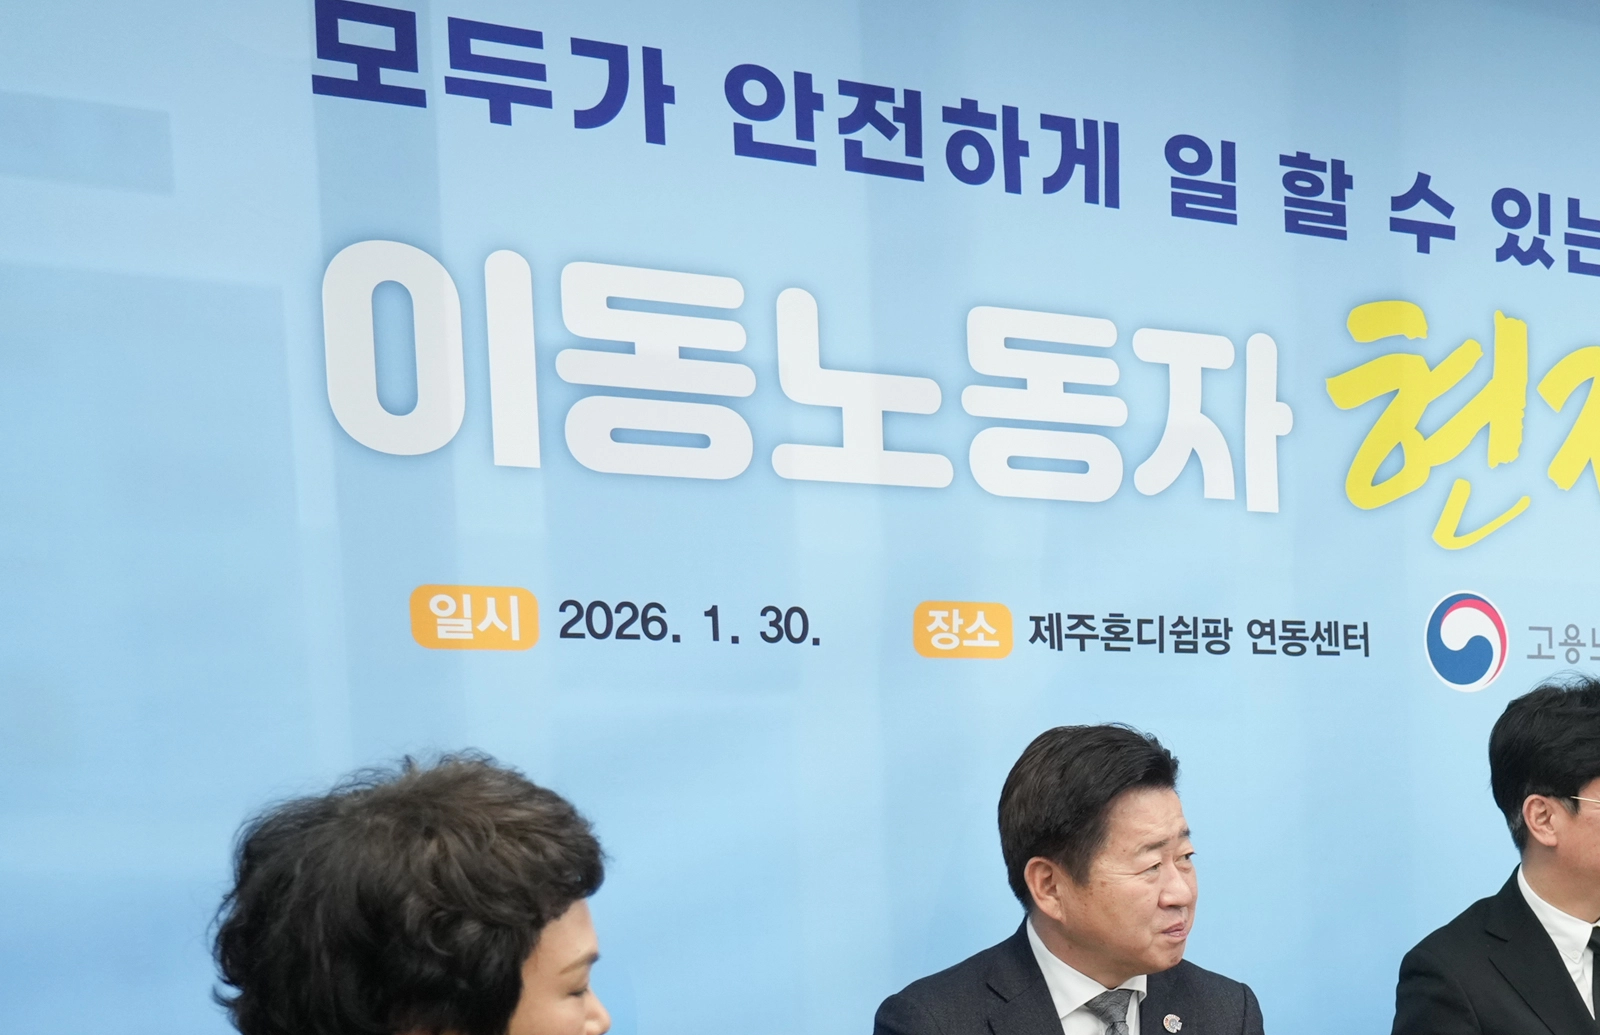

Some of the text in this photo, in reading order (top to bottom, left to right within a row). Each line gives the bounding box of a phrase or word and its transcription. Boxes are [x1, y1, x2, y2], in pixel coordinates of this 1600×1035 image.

[311, 0, 675, 145] 모두가
[723, 63, 1121, 210] 안전하게
[1164, 133, 1238, 226] 일
[1278, 150, 1353, 241] 할
[1389, 171, 1457, 254] 수
[321, 239, 1294, 514] 이동노동자
[428, 594, 821, 646] 일시 2026. 1. 30.
[925, 610, 1370, 659] 장소 제주혼디쉼팡 연동센터
